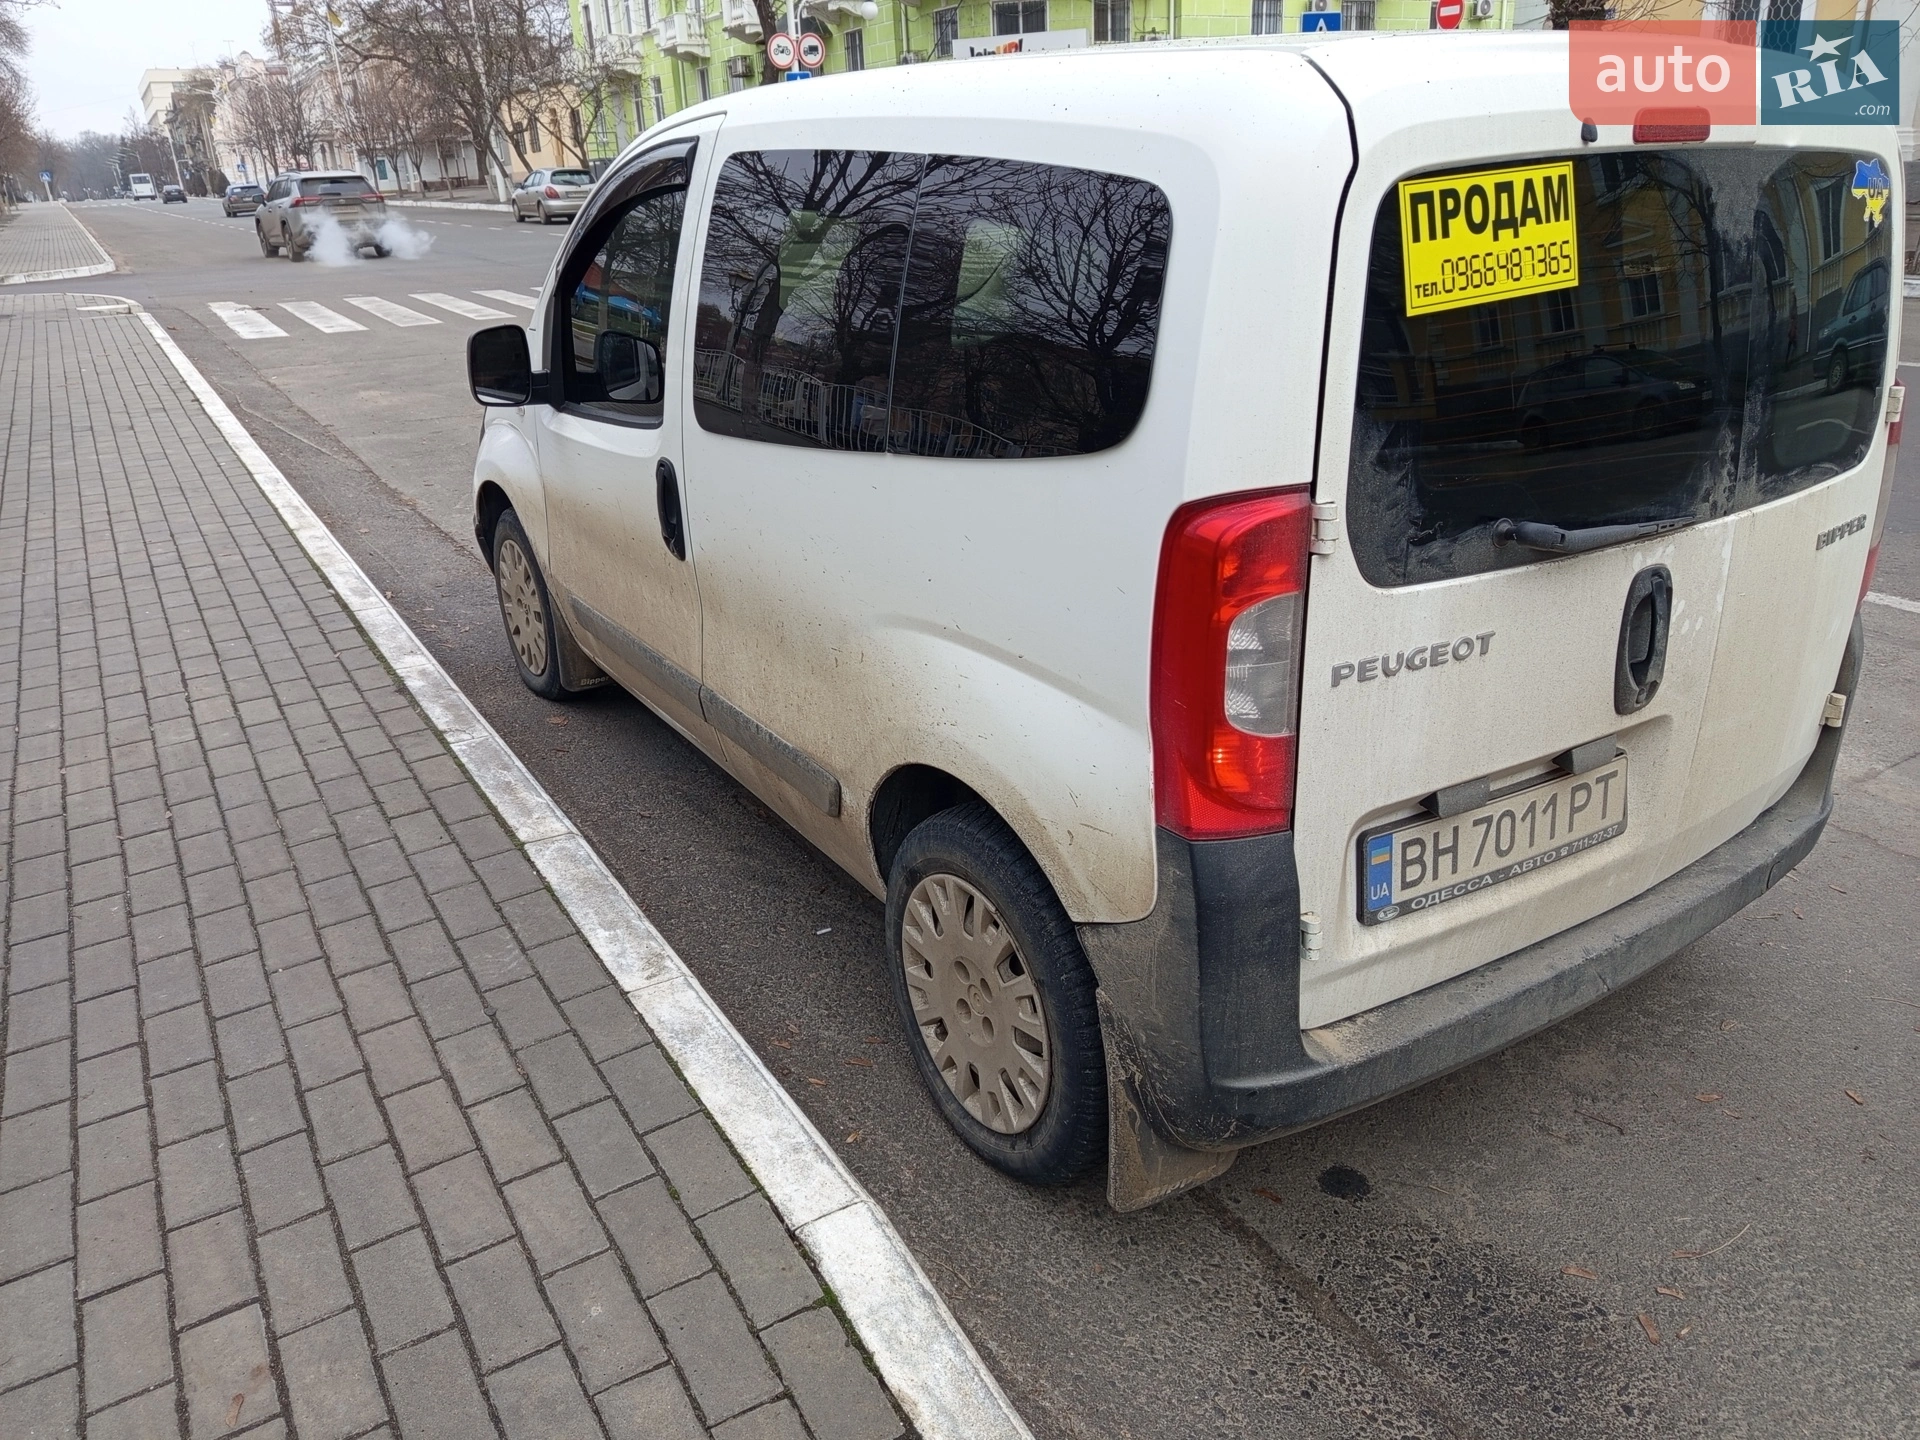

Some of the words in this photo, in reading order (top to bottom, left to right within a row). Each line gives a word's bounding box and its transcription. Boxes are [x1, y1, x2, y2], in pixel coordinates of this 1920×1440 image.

[1409, 173, 1570, 243] ПРОДАМ
[1441, 240, 1572, 294] 0966487365
[1815, 513, 1867, 551] BIPPER
[1331, 630, 1496, 687] PEUGEOT
[1472, 792, 1558, 868] 7011
[1370, 882, 1390, 900] UA
[1411, 875, 1494, 910] ОДЕССА
[1571, 824, 1619, 853] 711-27-37
